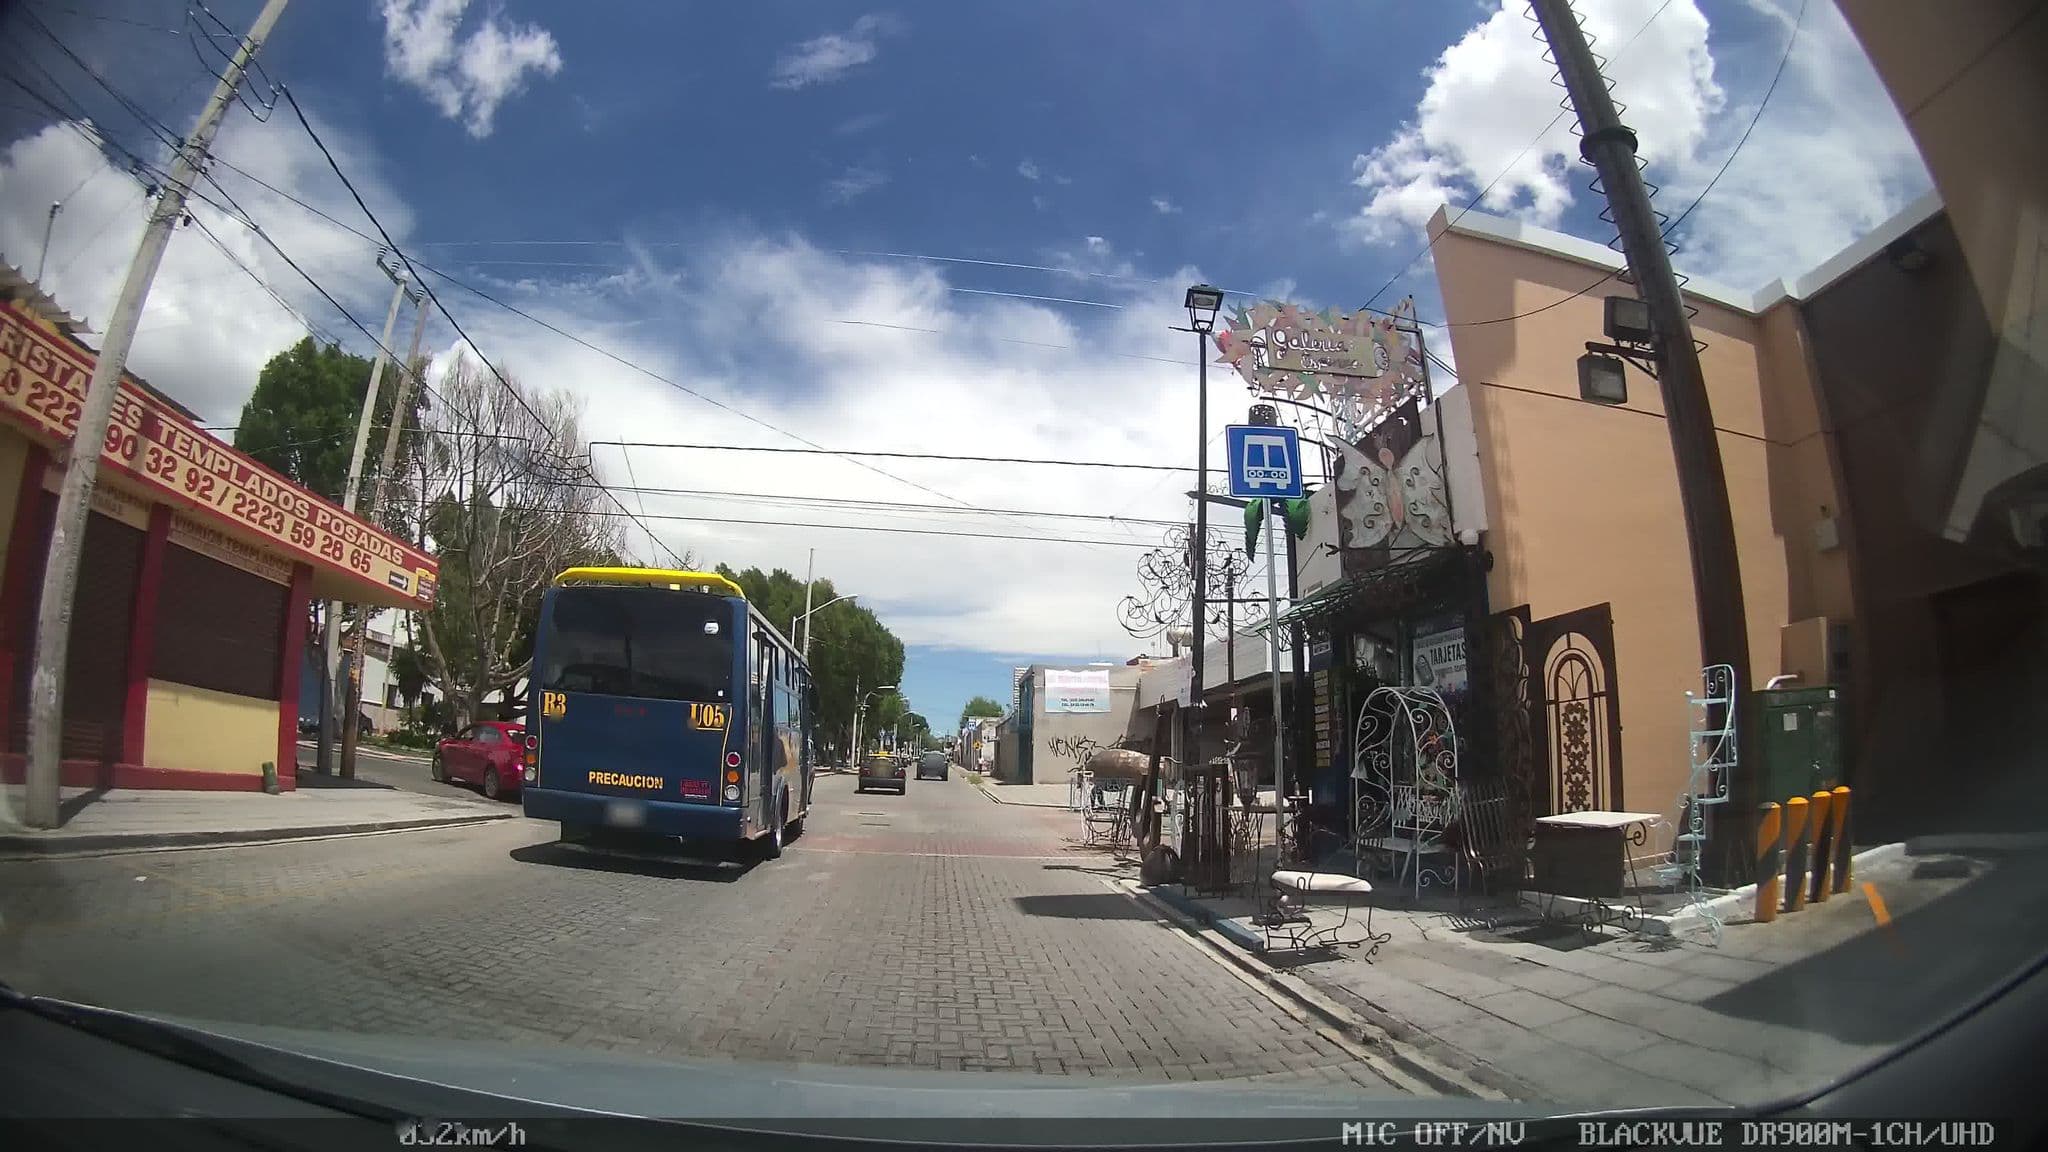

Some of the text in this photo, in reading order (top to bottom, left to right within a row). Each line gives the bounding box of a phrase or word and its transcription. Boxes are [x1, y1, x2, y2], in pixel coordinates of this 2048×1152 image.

[105, 424, 138, 461] 90
[146, 447, 176, 483] 32
[186, 468, 215, 502] 92
[232, 492, 285, 535] 2223
[290, 522, 317, 549] 59
[321, 535, 345, 561] 28
[350, 548, 372, 574] 65
[158, 419, 310, 520] TEMPLADOS
[316, 512, 405, 565] POSADAS
[588, 771, 664, 790] PRECAUCION
